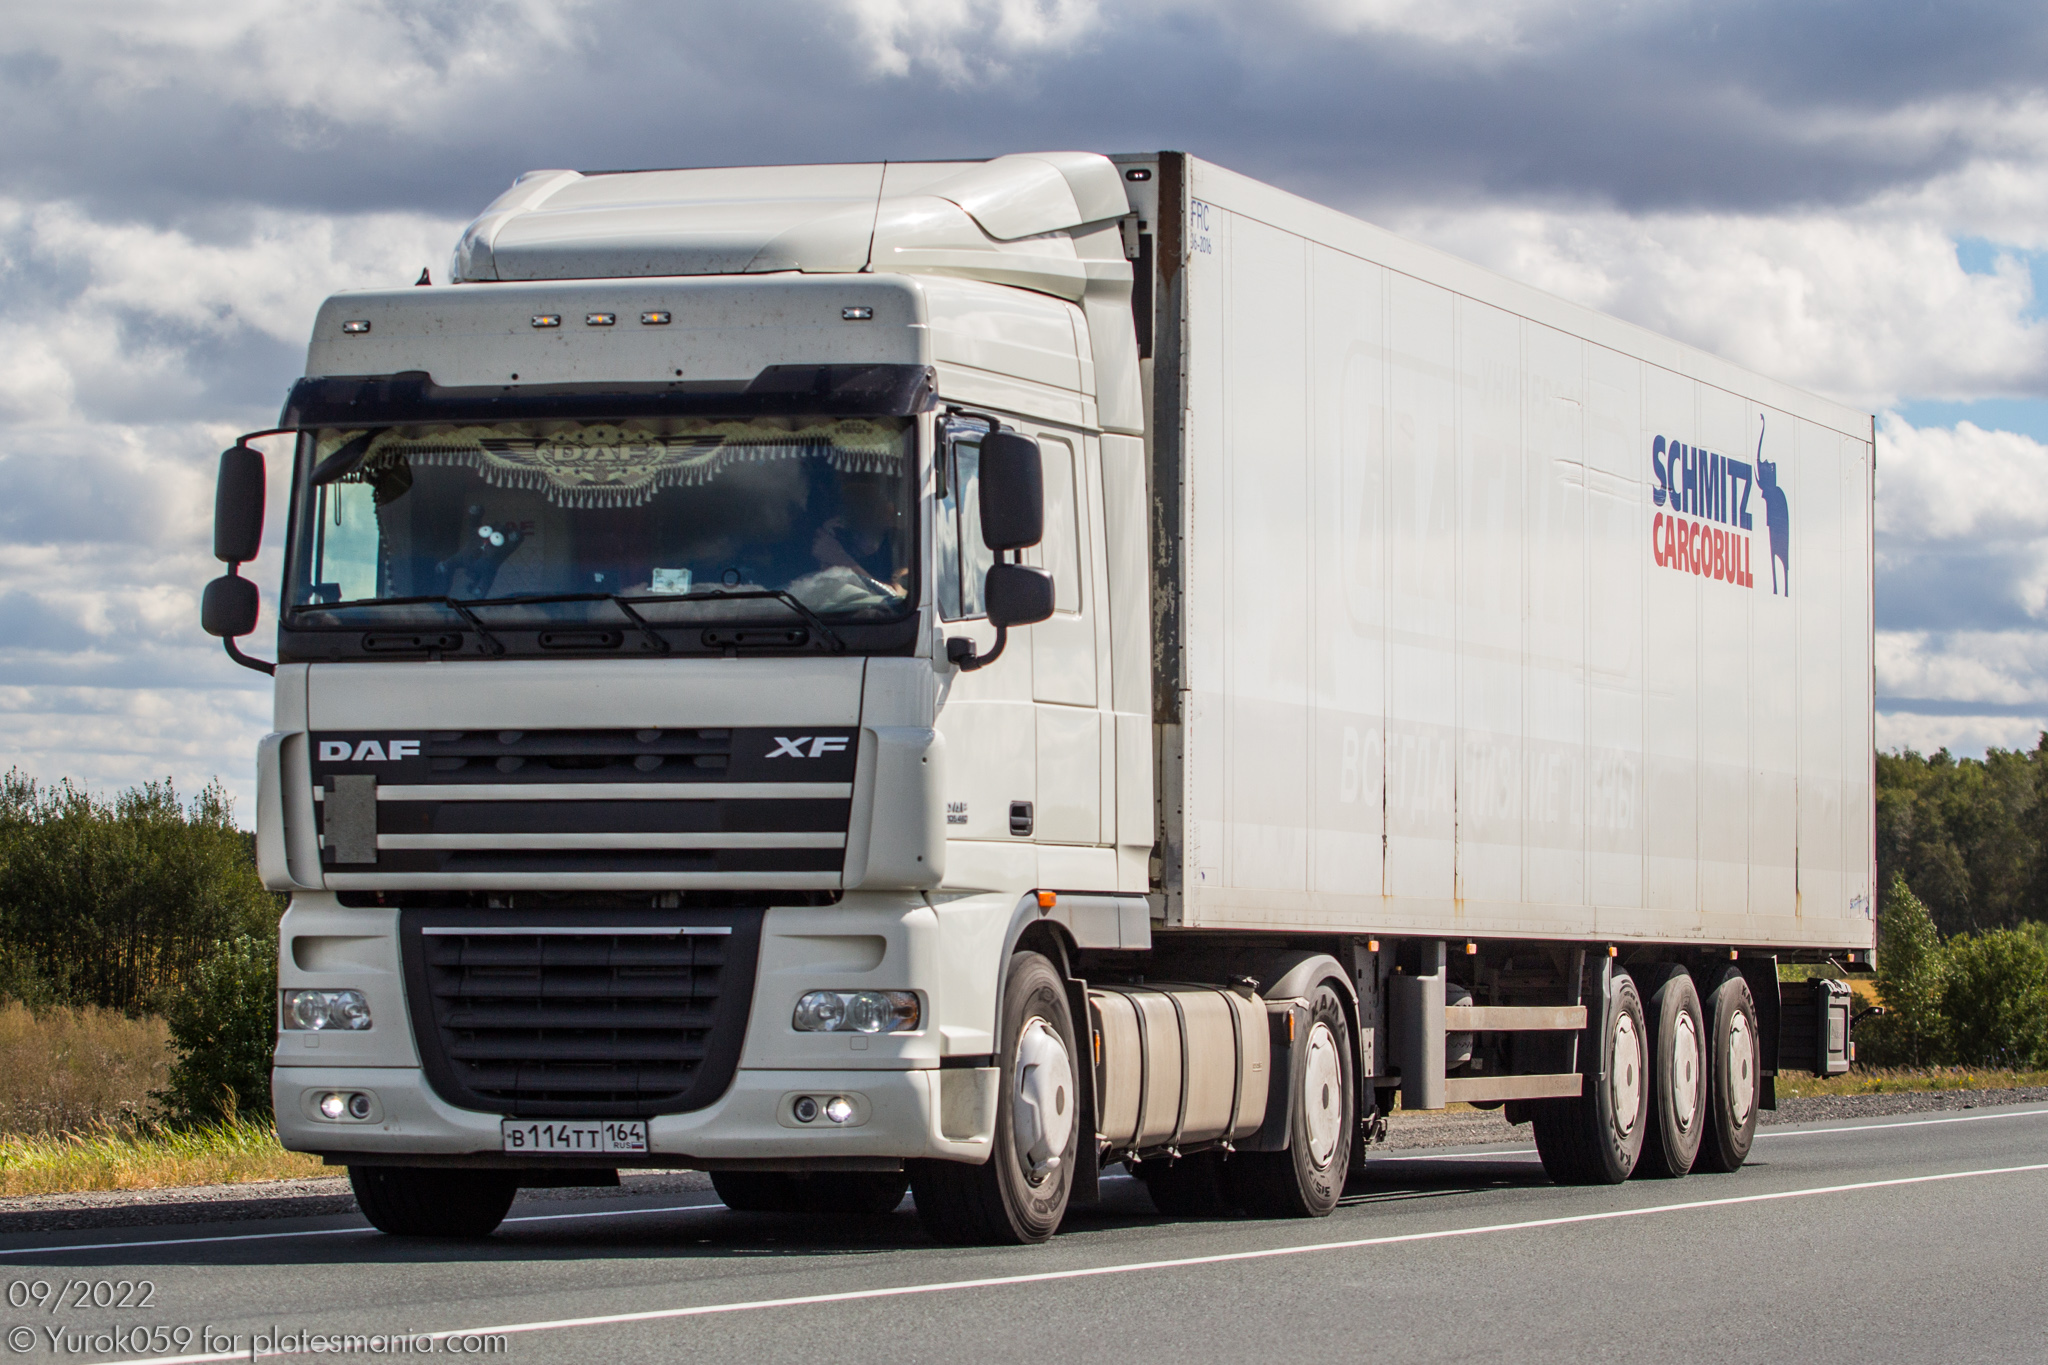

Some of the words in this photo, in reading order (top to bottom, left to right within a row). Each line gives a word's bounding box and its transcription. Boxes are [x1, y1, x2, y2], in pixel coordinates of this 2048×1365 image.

[1190, 200, 1210, 232] FRC
[554, 443, 648, 461] DAF
[1653, 435, 1752, 531] SCHMITZ
[1653, 512, 1753, 589] CARGOBULL
[319, 740, 421, 761] DAF
[764, 737, 849, 758] XF
[606, 1123, 641, 1142] 164
[613, 1141, 631, 1149] RUS
